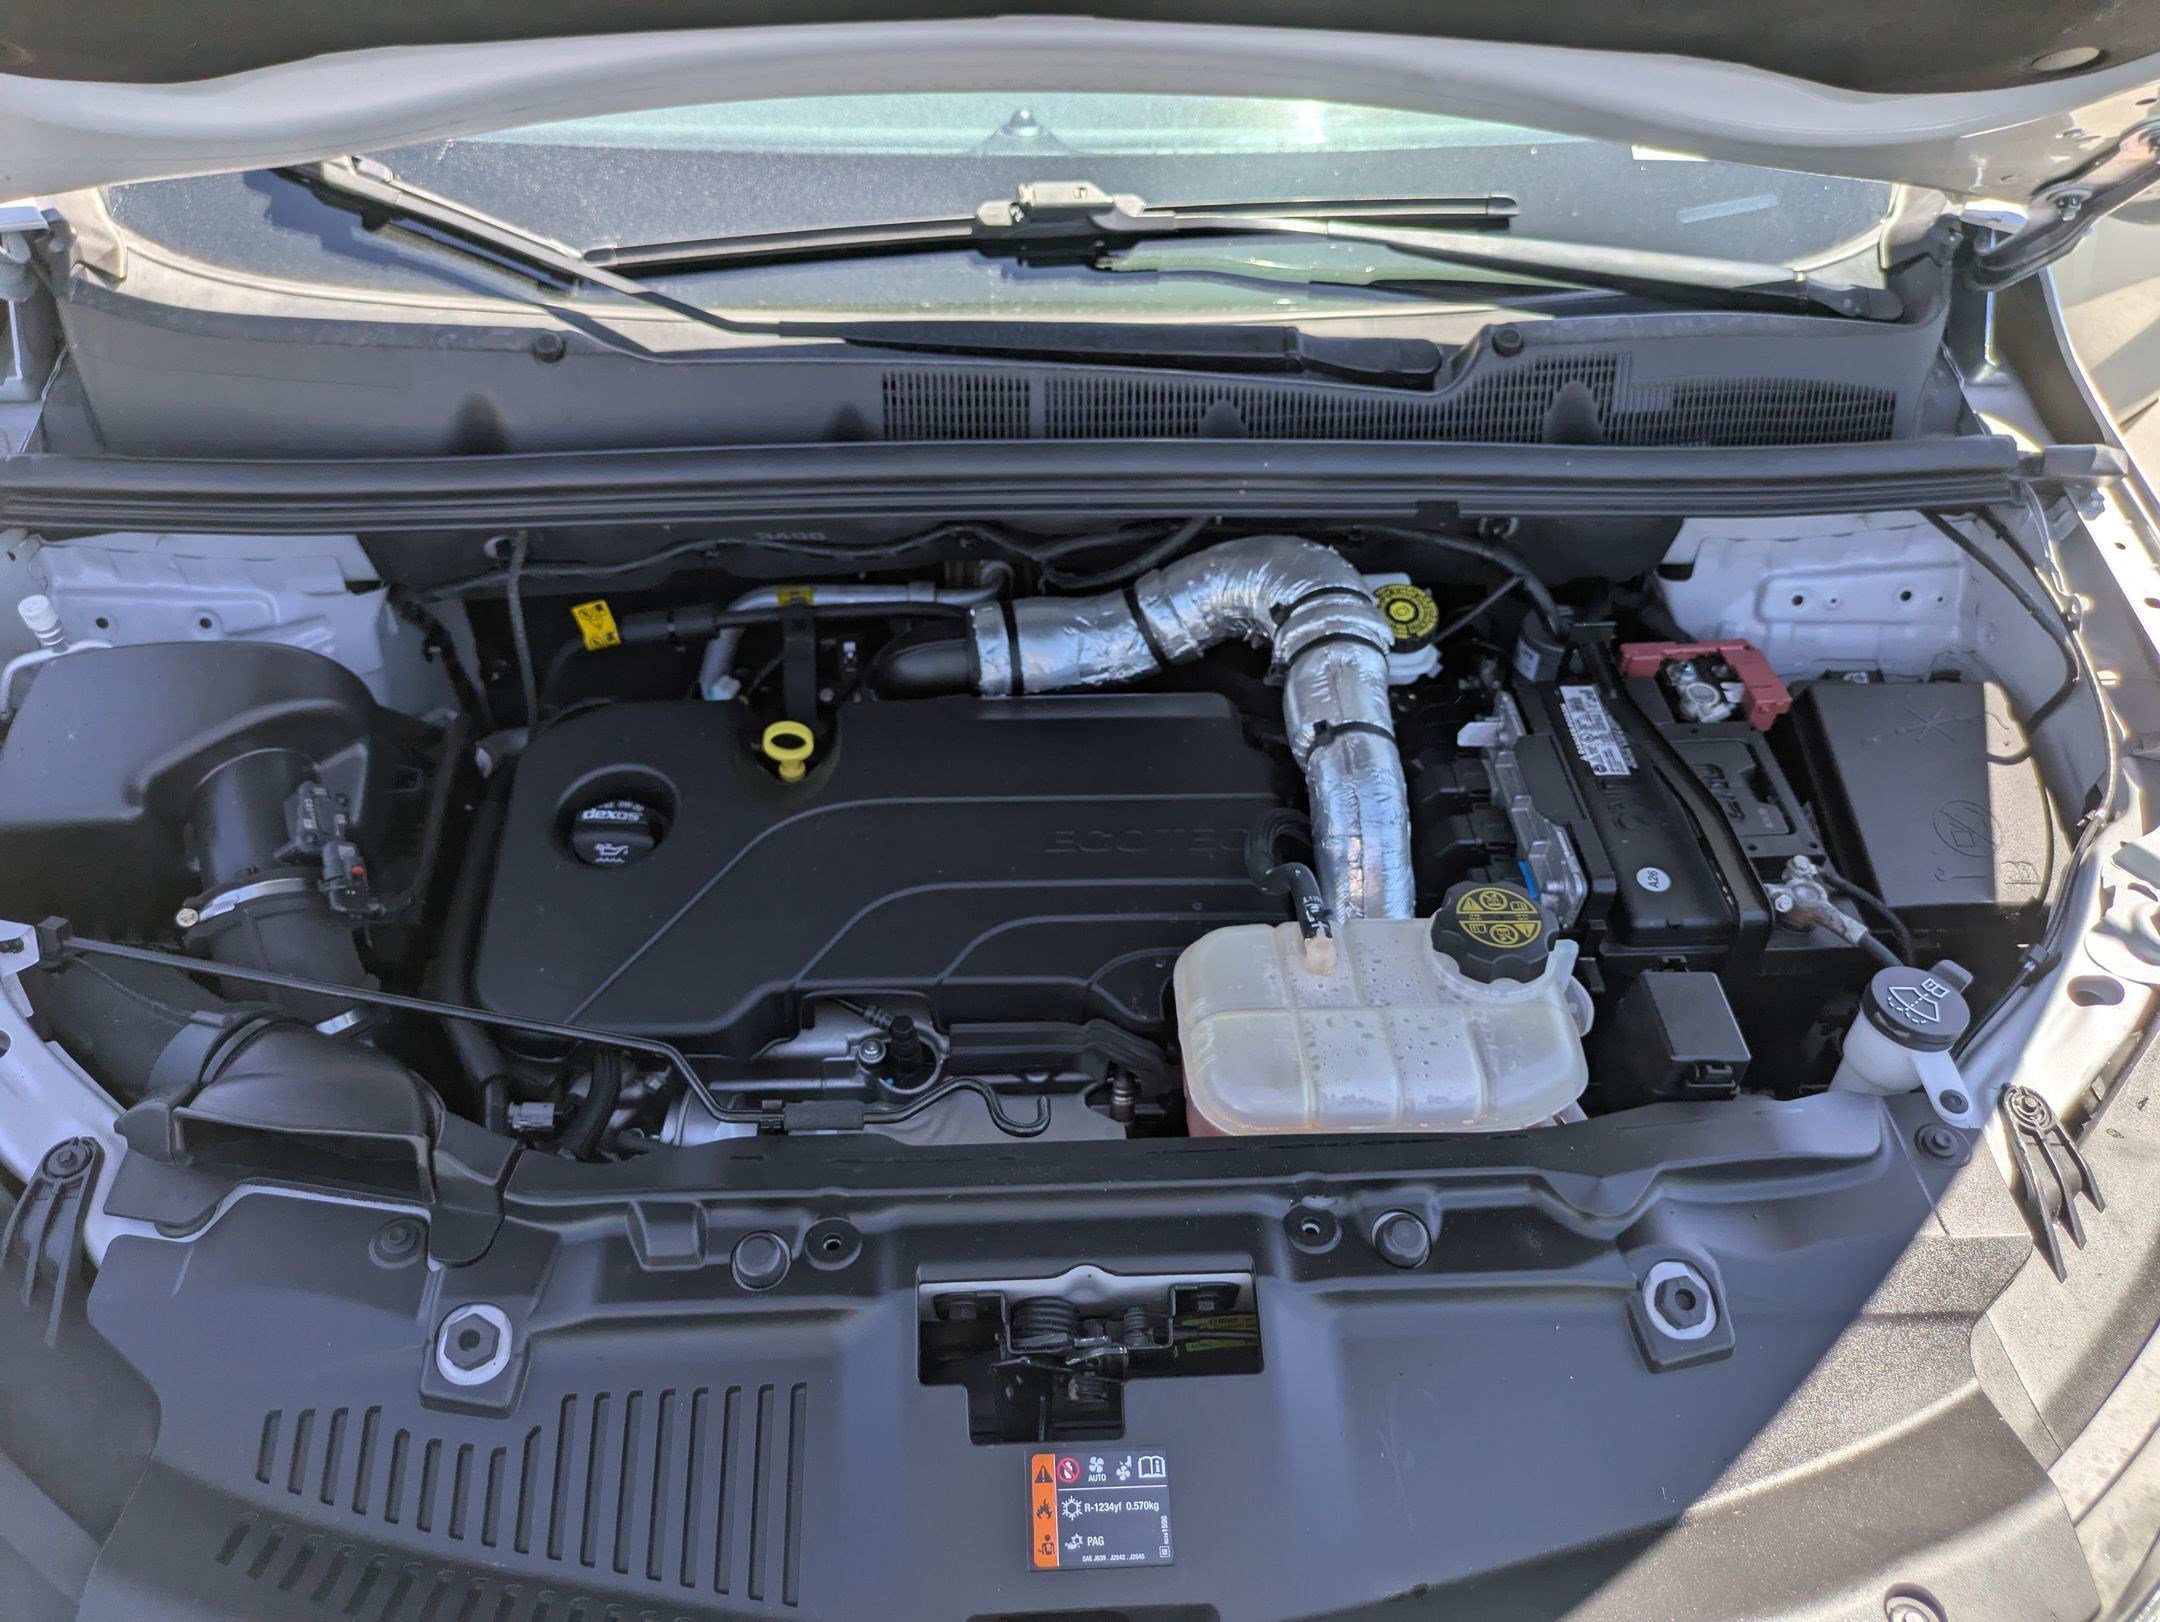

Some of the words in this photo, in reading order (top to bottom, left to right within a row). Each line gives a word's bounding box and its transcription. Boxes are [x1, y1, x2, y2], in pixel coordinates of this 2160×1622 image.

[1647, 870, 1659, 888] A26
[1088, 1473, 1107, 1482] AUTO
[1084, 1501, 1122, 1513] R-1234yf
[1125, 1501, 1160, 1512] 0.570kg
[1087, 1536, 1105, 1546] PAG
